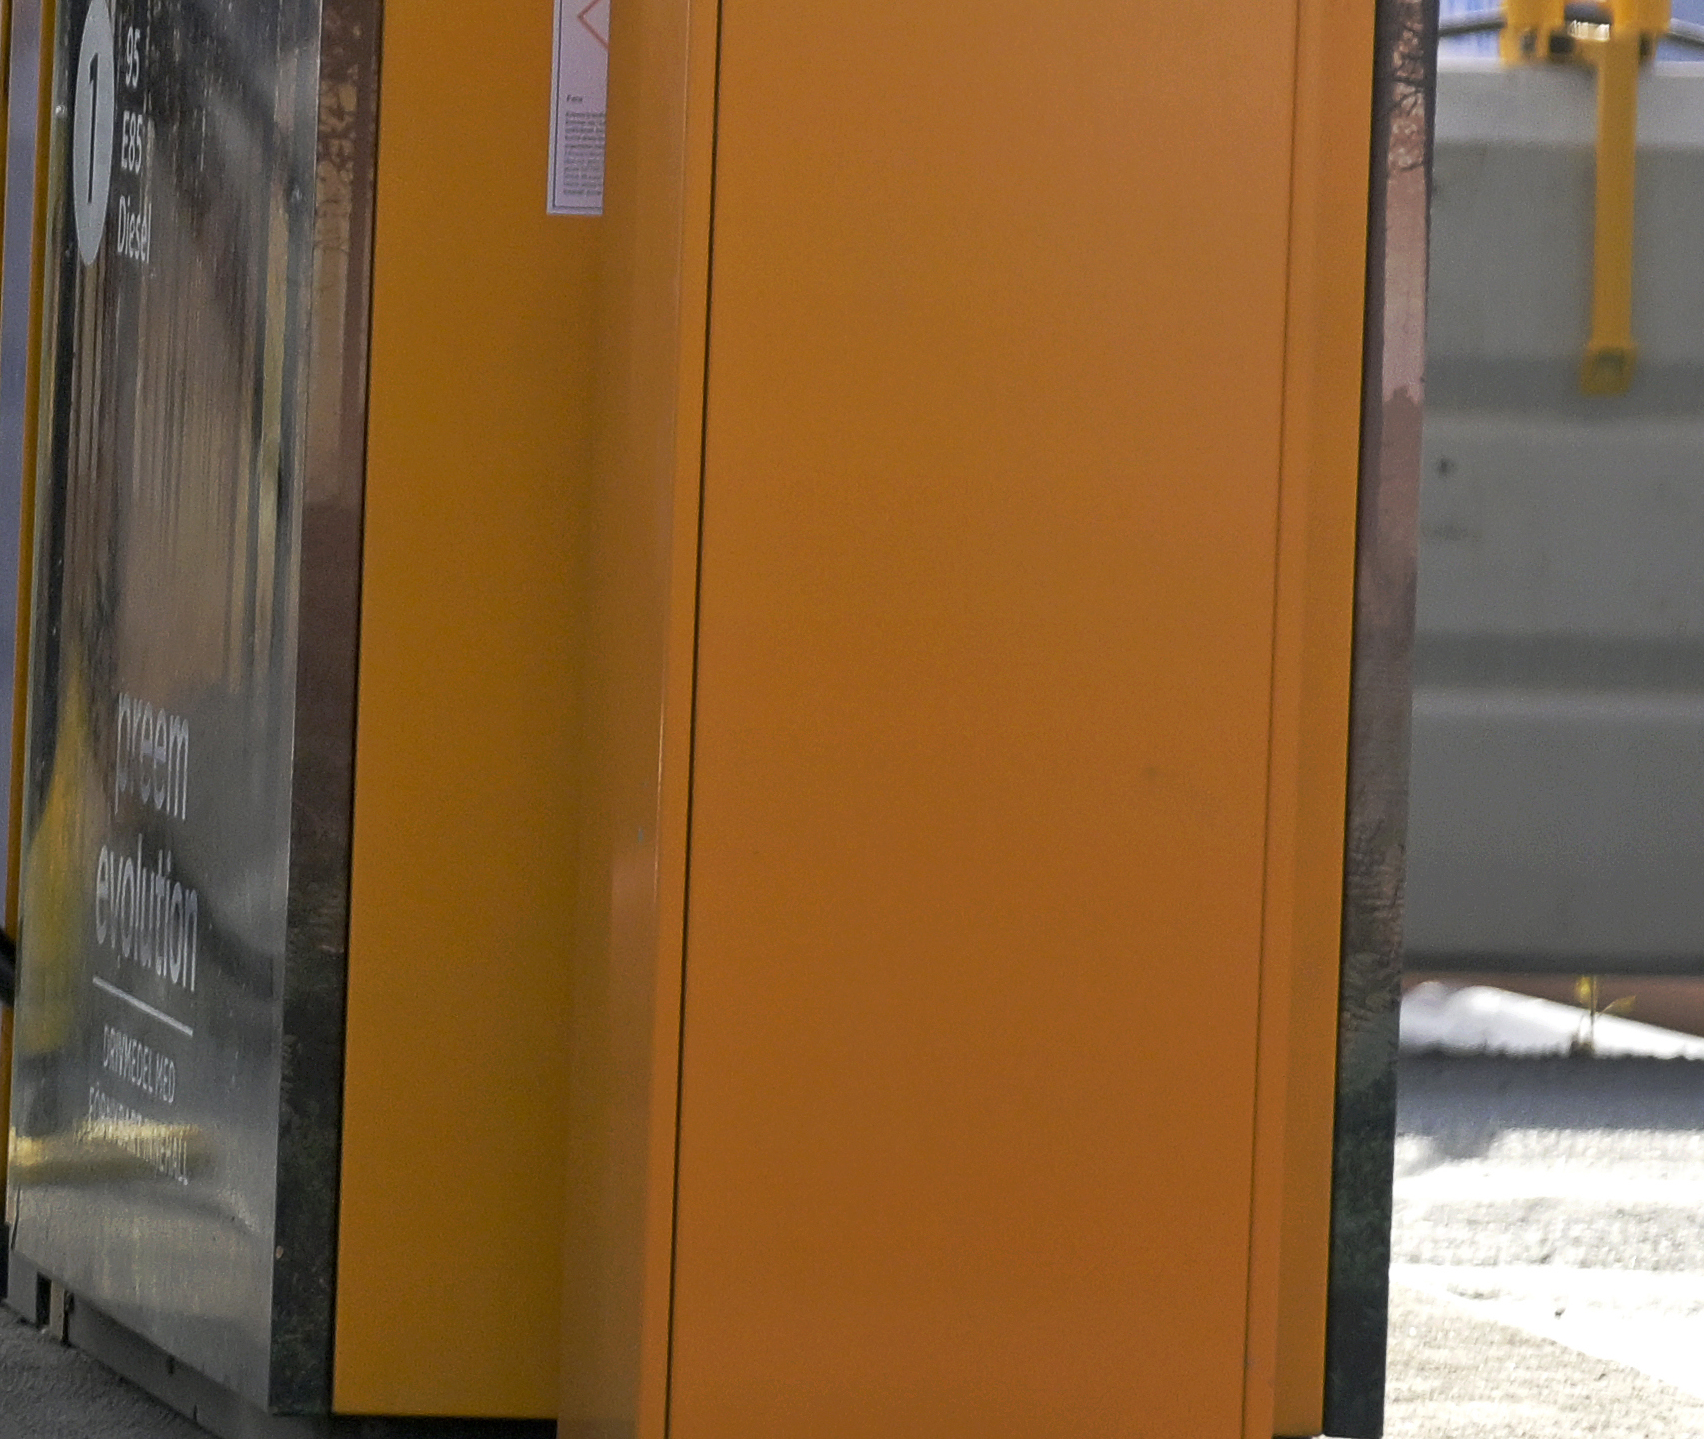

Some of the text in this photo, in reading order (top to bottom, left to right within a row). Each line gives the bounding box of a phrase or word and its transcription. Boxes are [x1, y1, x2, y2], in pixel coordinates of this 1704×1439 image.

[125, 26, 141, 89] 95
[88, 52, 99, 204] 1
[121, 110, 143, 175] E85
[117, 195, 152, 264] Diesel
[114, 692, 189, 821] preem
[96, 832, 198, 993] evolution
